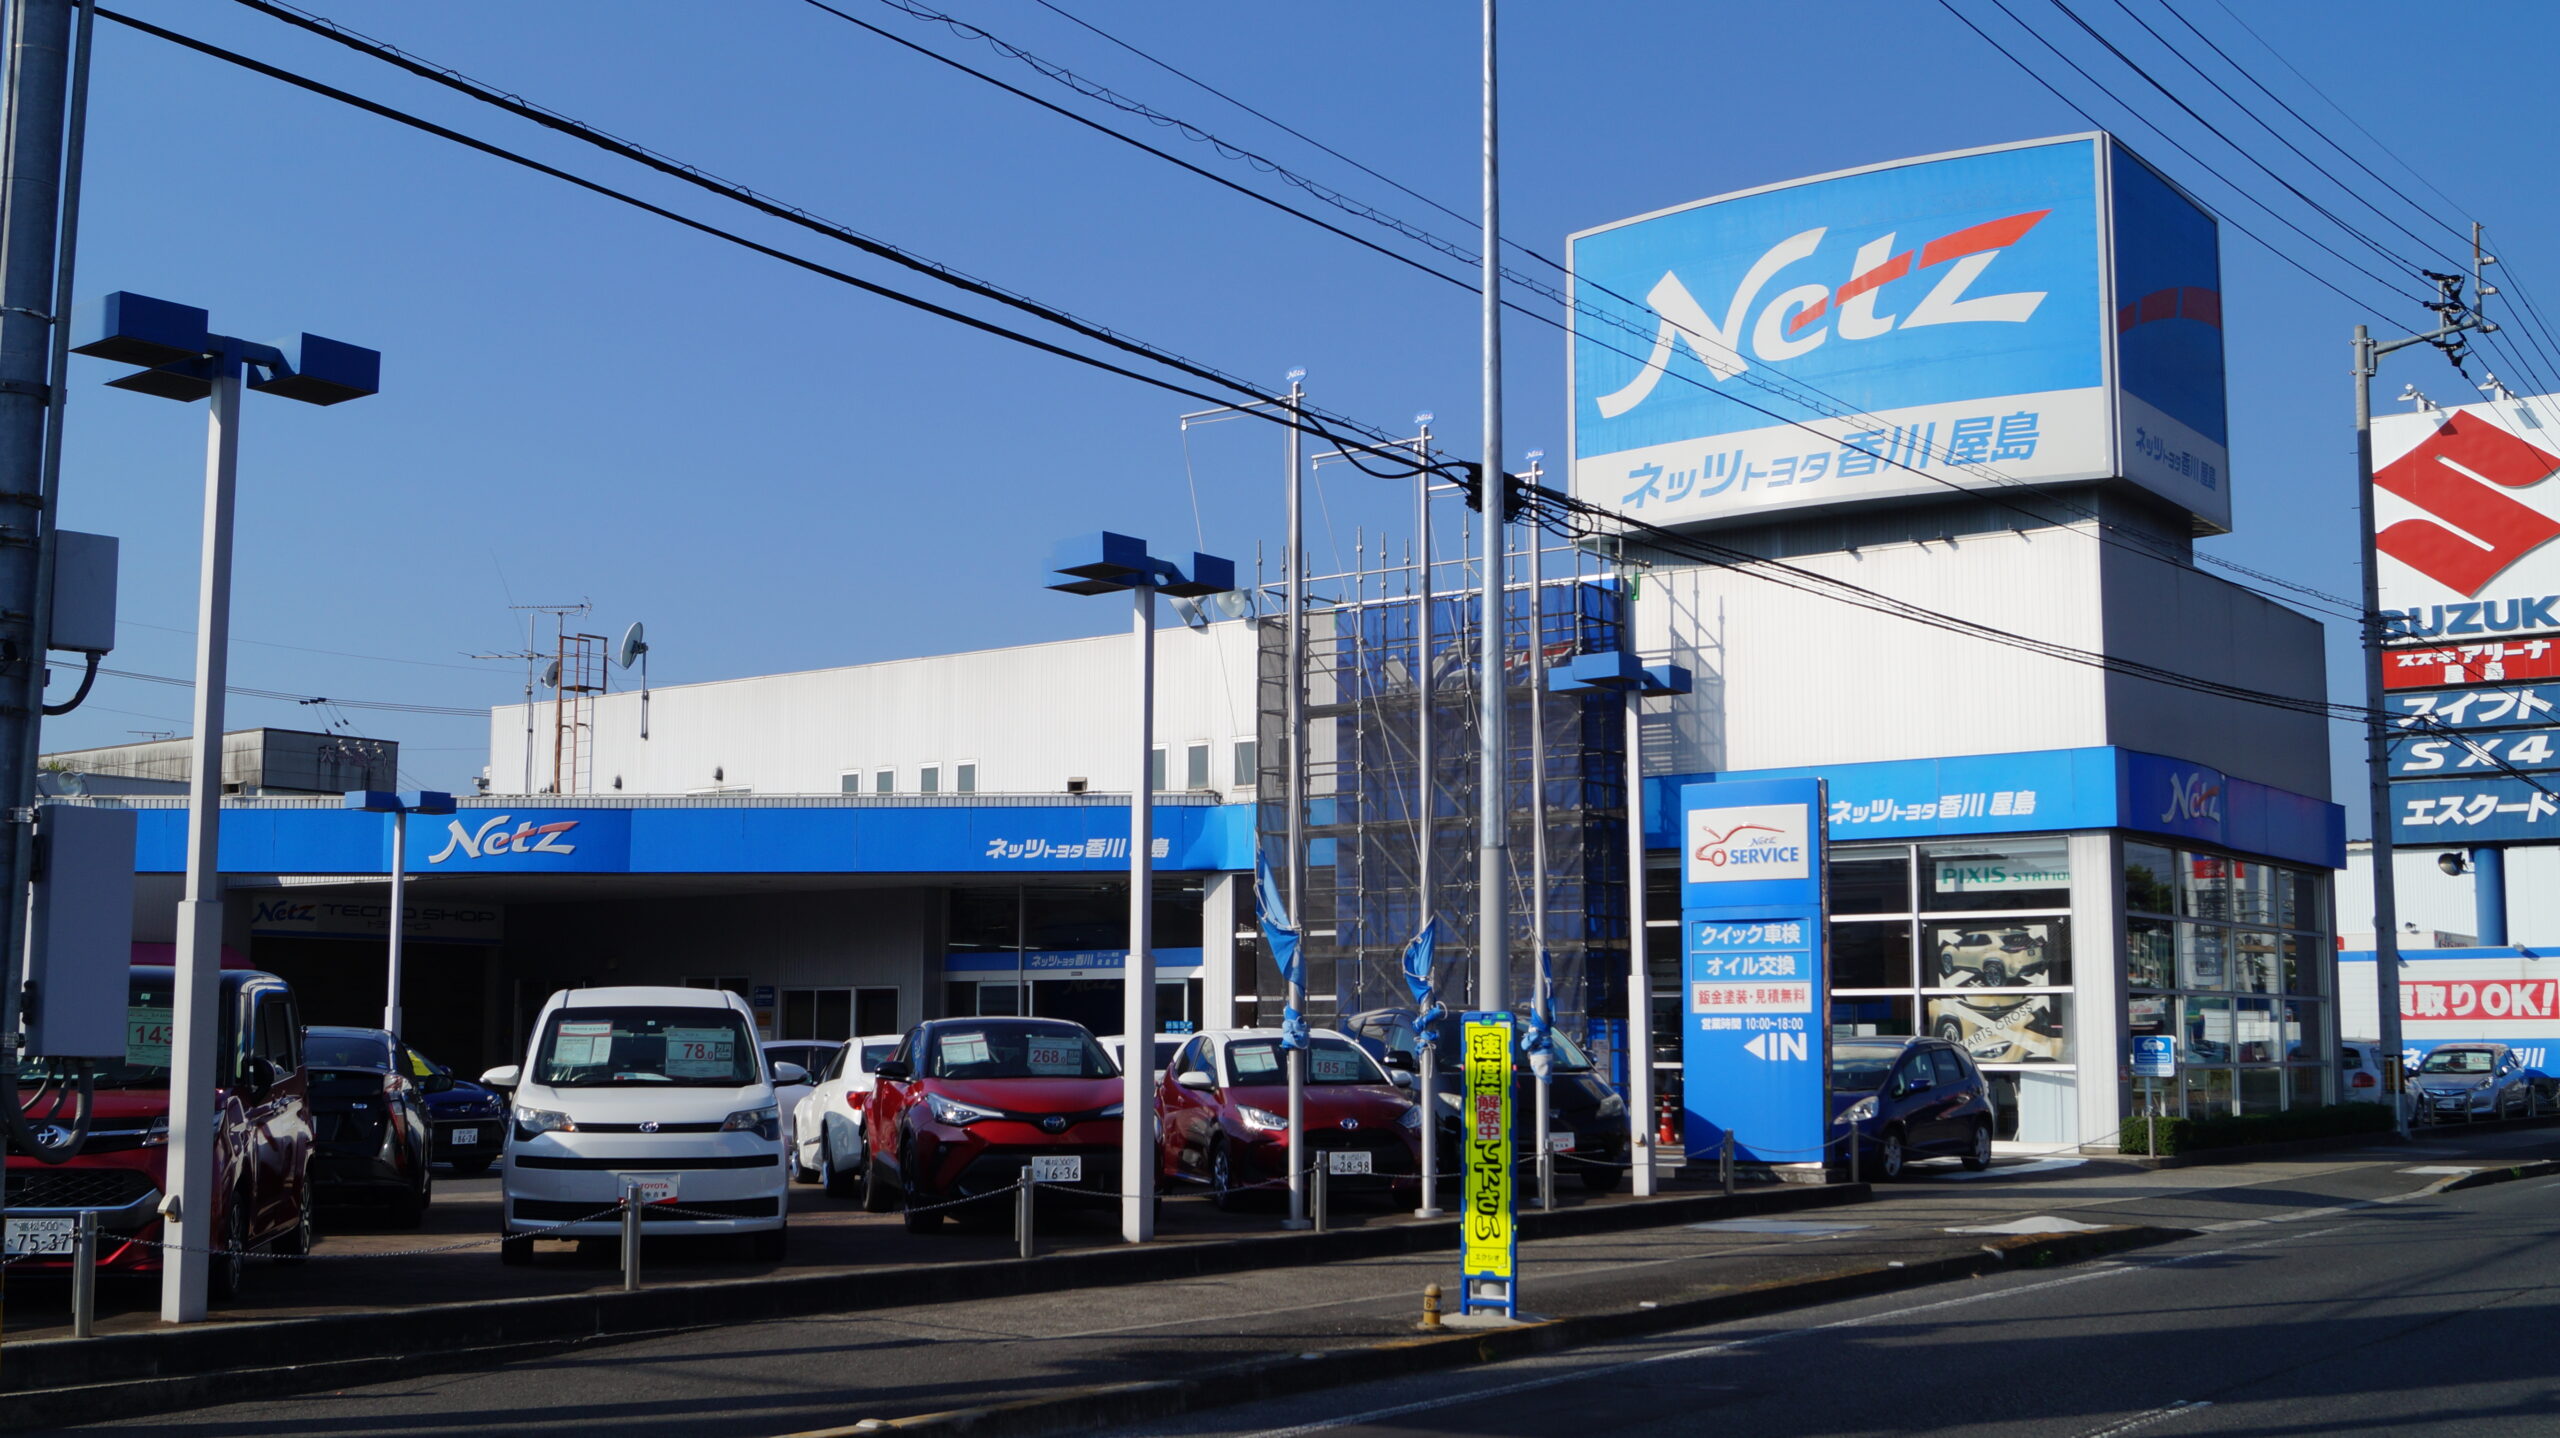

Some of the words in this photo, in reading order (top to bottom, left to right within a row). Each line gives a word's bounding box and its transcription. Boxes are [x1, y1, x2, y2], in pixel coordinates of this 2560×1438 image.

[1597, 209, 2052, 418] Netz
[1622, 421, 1933, 509] ネッツトヨタ香川
[1949, 411, 2039, 464] 屋島
[2397, 689, 2553, 728] スイフト
[1829, 793, 1985, 824] ネッツトヨタ香川
[1989, 790, 2036, 816] 屋島
[2161, 772, 2221, 824] Netz
[2402, 791, 2560, 826] エスクード
[428, 815, 580, 864] Netz
[985, 838, 1127, 859] ネッツトヨタ香川
[1729, 847, 1799, 864] SERVICE
[1941, 866, 2007, 885] PIXIS
[250, 900, 317, 923] Netz
[422, 909, 496, 923] SHOP
[1701, 924, 1801, 945] クイック車検
[1032, 953, 1094, 967] ネッツトヨタ香川
[1707, 955, 1796, 976] オイル交換
[1701, 1018, 1742, 1030] 営業時間
[1995, 1003, 2033, 1031] CROSS
[1769, 1032, 1807, 1061] IN
[1477, 1095, 1501, 1140] 解除中
[1044, 1166, 1079, 1179] 16-36
[17, 1233, 70, 1251] 75-37
